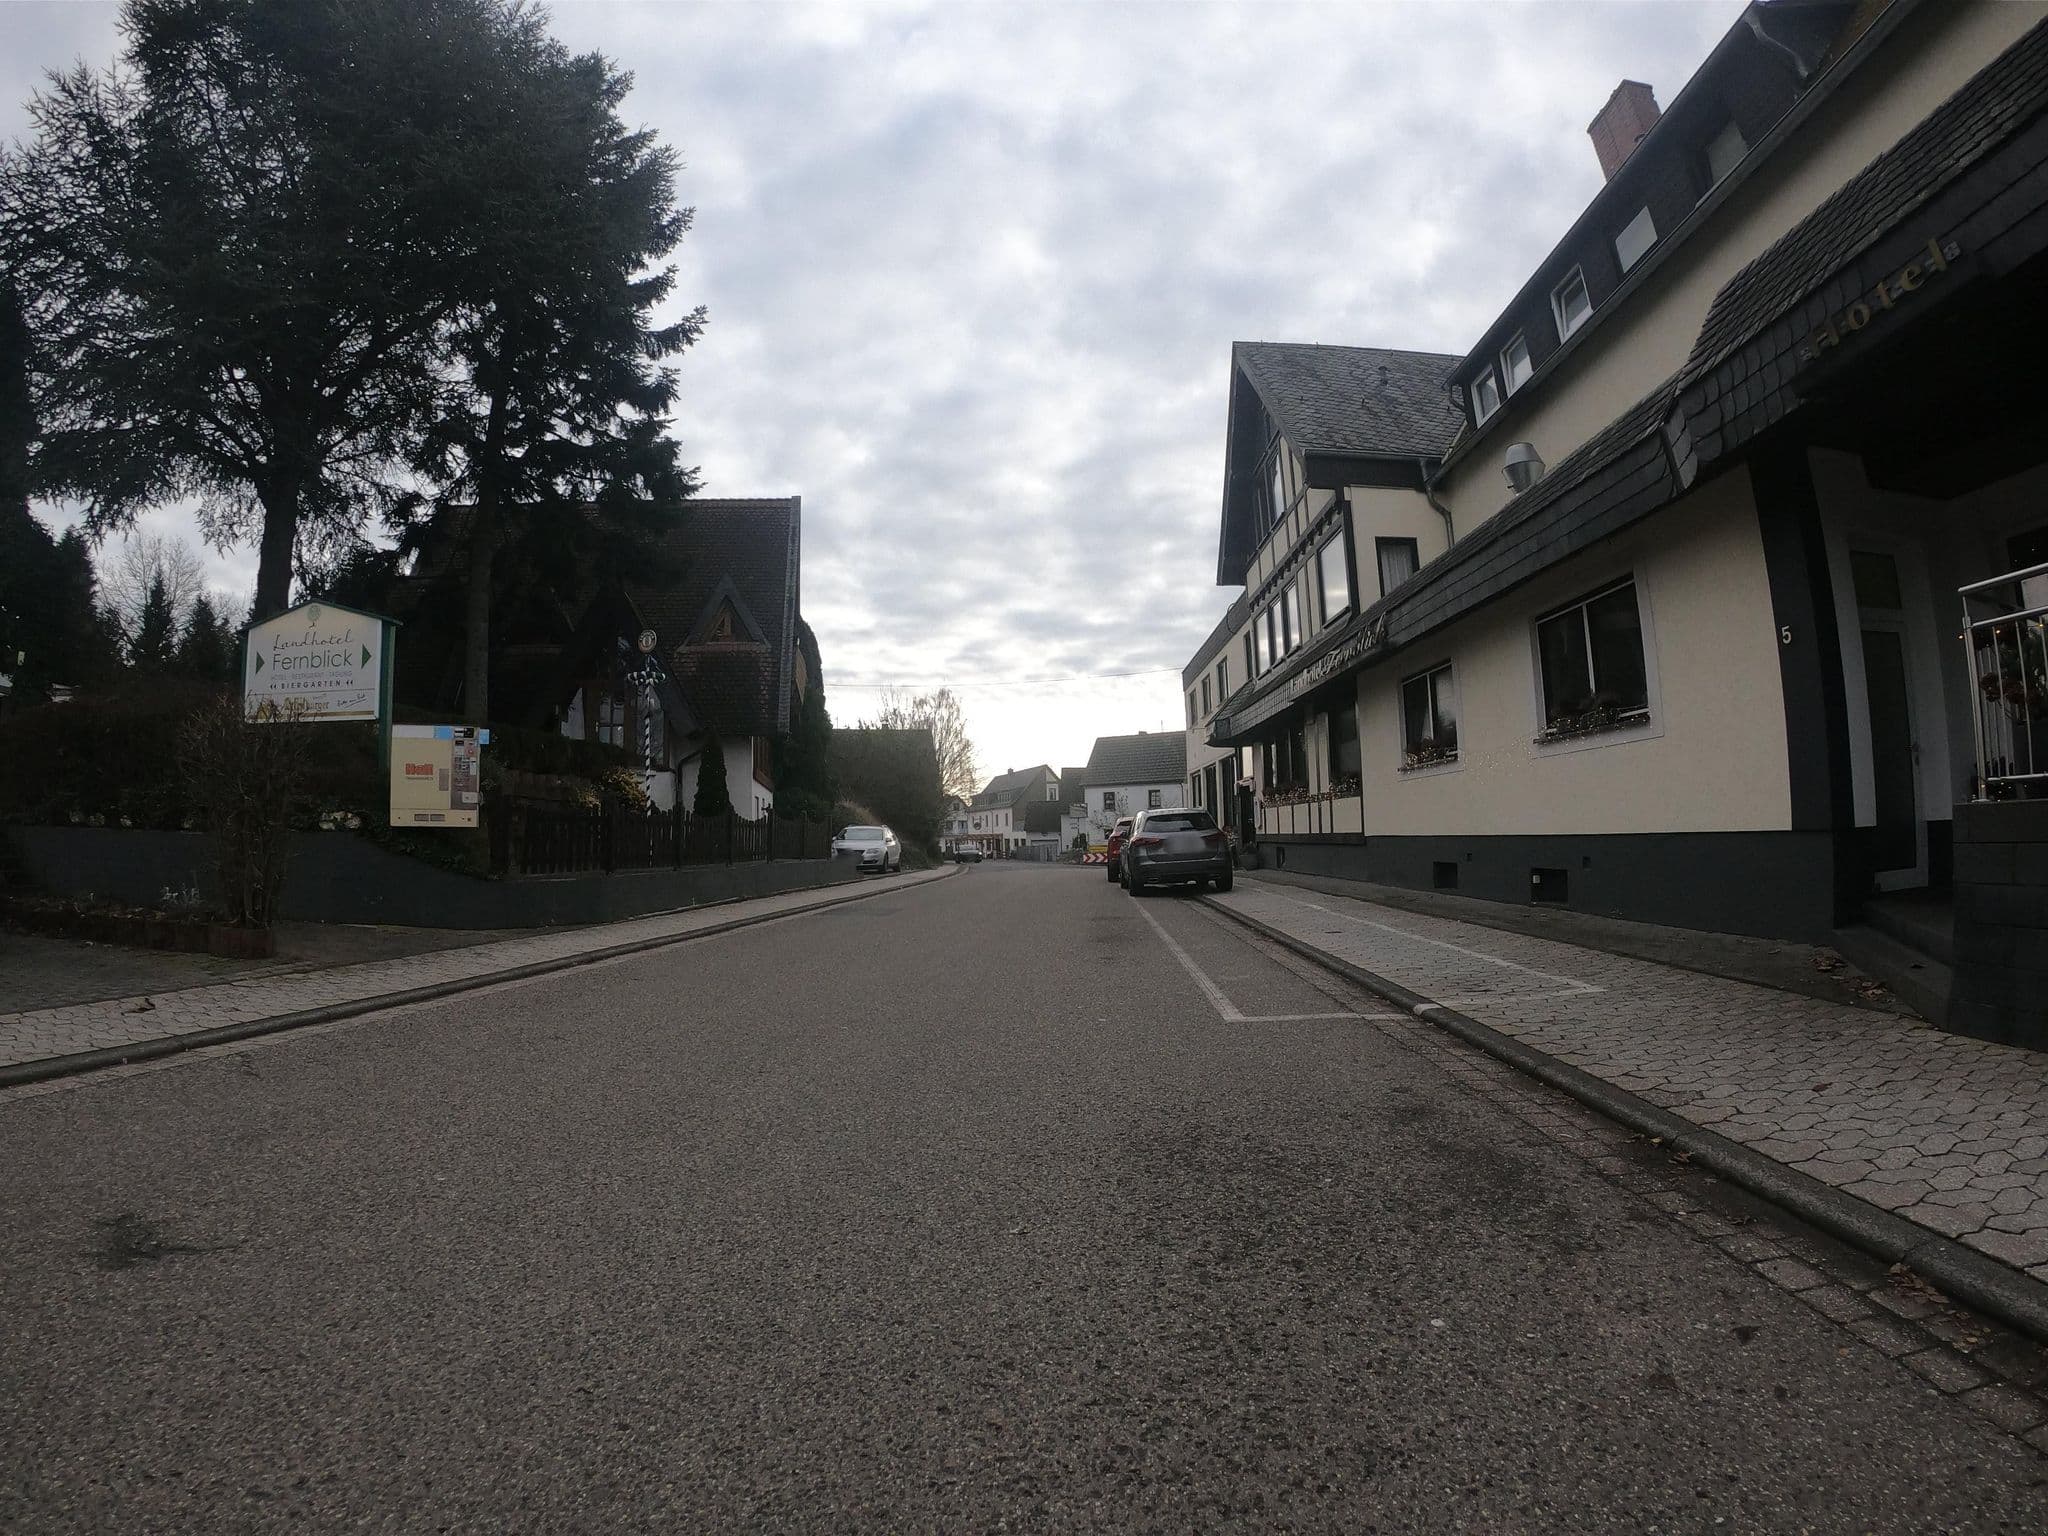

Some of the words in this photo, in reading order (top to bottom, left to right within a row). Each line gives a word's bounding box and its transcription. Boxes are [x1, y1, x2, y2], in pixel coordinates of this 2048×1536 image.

[273, 629, 353, 651] Landhotel
[1781, 625, 1792, 644] 5
[273, 648, 352, 670] Fernblick
[281, 679, 341, 689] BIERGARTEN
